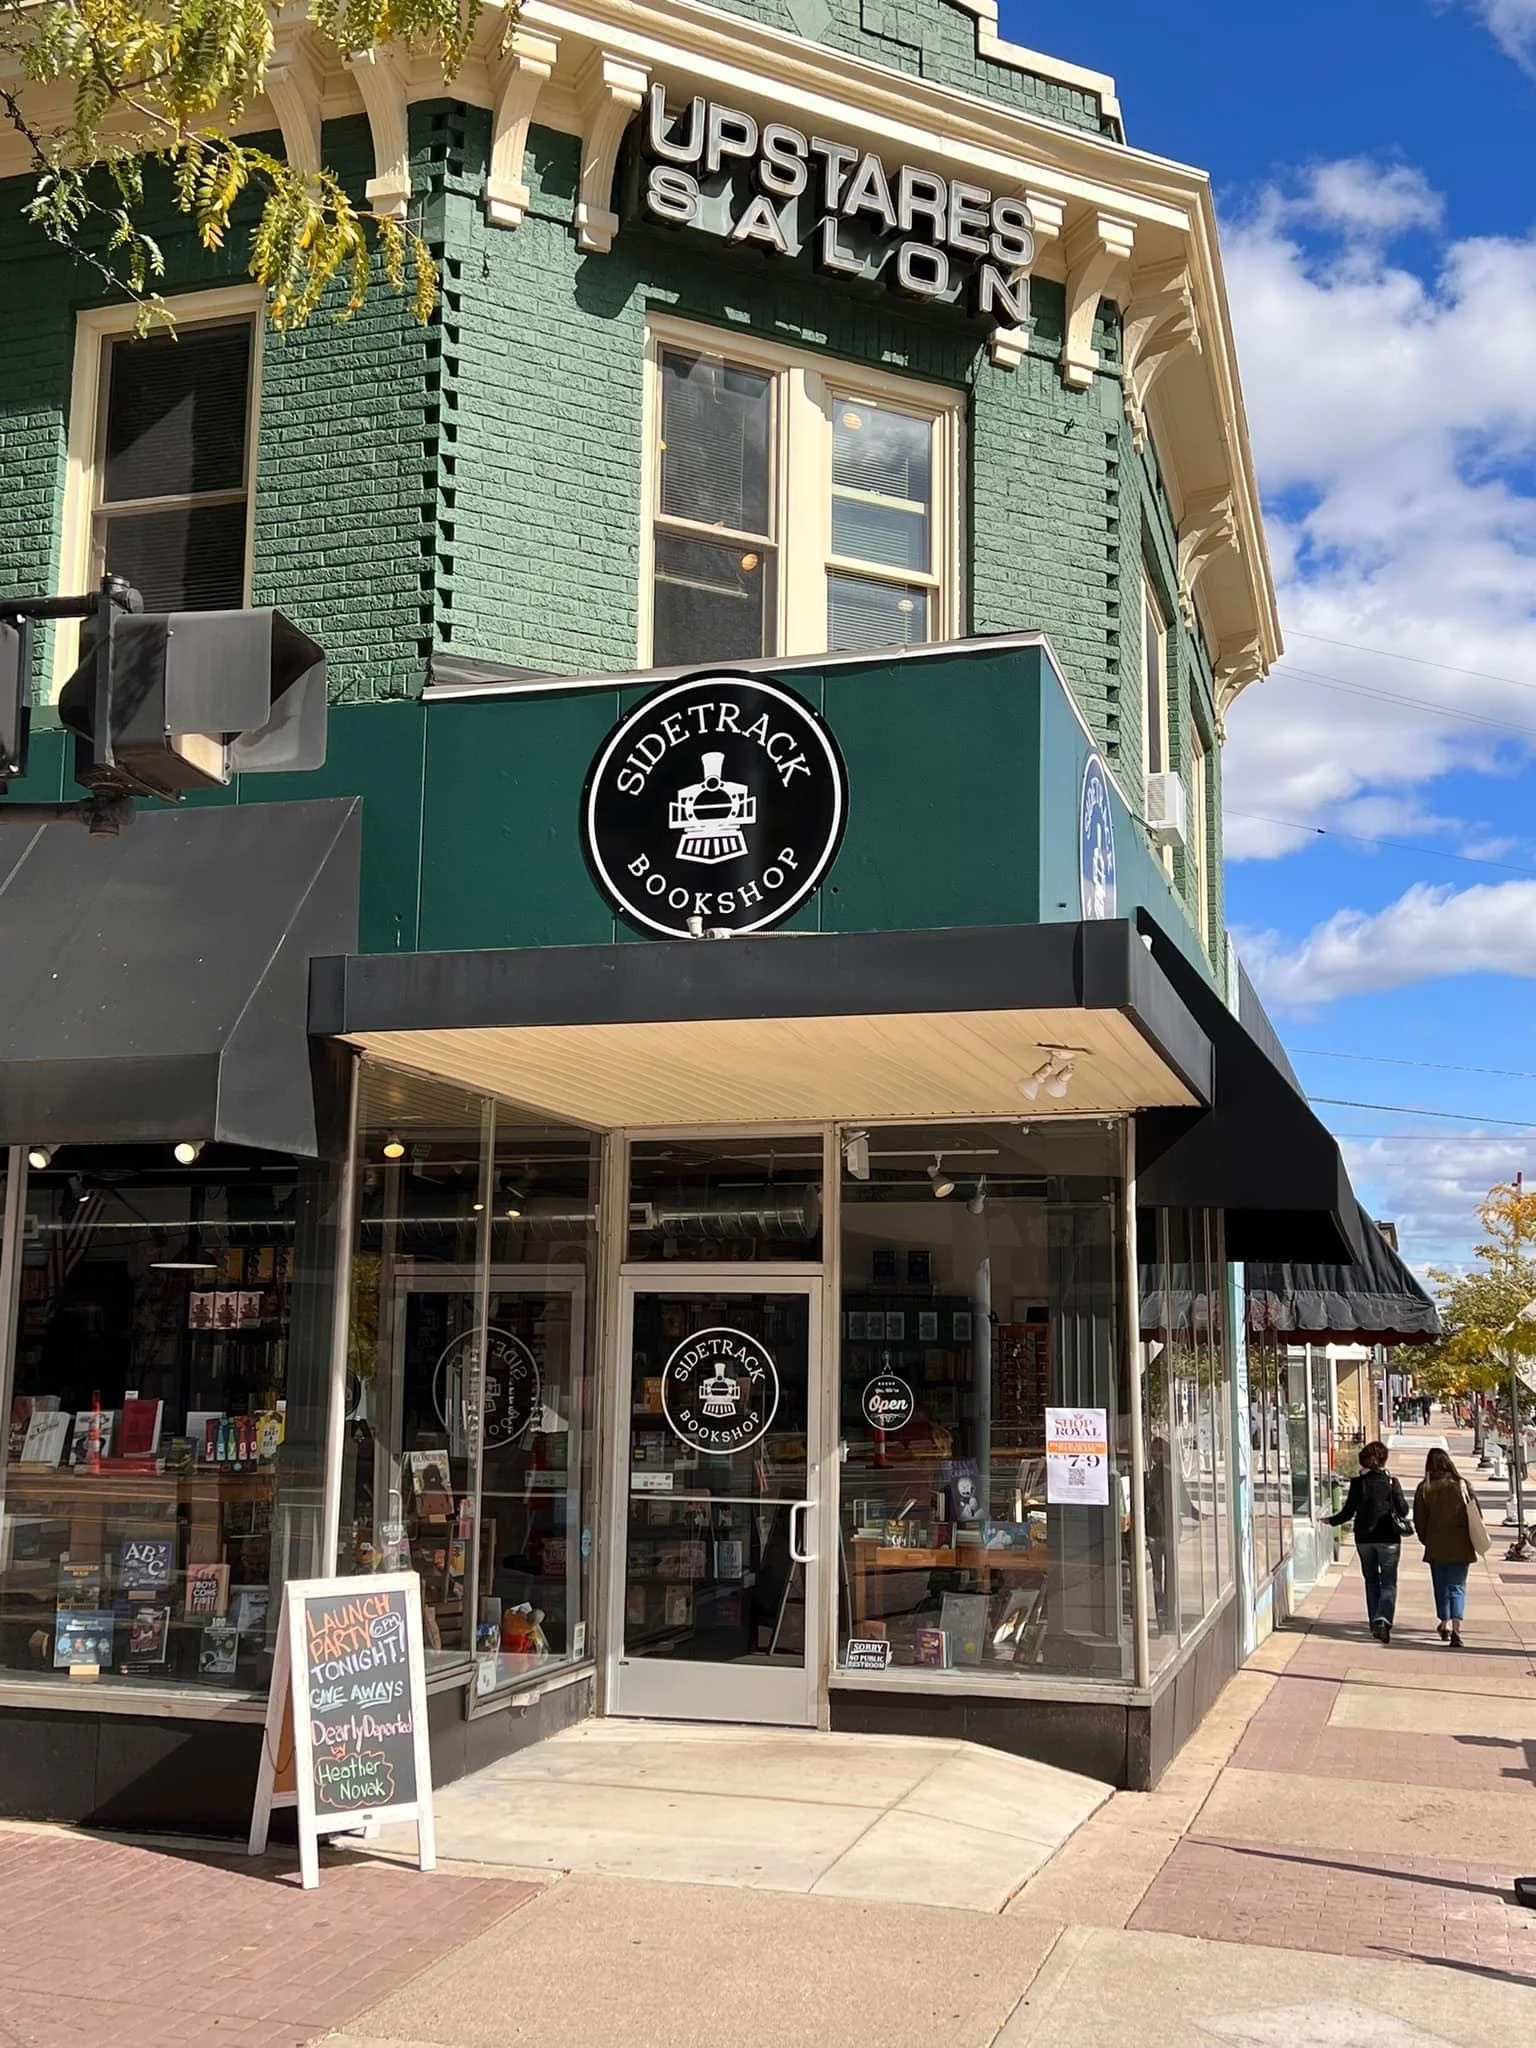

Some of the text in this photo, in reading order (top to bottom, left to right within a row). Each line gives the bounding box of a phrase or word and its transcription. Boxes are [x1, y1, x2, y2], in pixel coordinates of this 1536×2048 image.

[648, 82, 1036, 268] UPSTARES
[645, 164, 1032, 326] SALON
[616, 702, 812, 798] SIDETRACK
[627, 846, 801, 917] BOOKSHOP
[674, 1338, 766, 1384] SIDETRACK
[869, 1395, 909, 1413] Open
[679, 1409, 760, 1443] BOOKSHOP
[1055, 1420, 1093, 1429] SHOP
[1056, 1428, 1101, 1437] ROYAL
[1068, 1454, 1101, 1468] 7-9
[306, 1594, 390, 1638] LAUNCH
[310, 1615, 398, 1664] PARTY 6PM
[311, 1620, 405, 1684] TONIGHT!
[853, 1643, 884, 1653] SORRY
[860, 1655, 884, 1663] PUBLIC
[309, 1680, 404, 1709] GIVE AWAYS
[311, 1714, 363, 1753] Dearly
[319, 1757, 382, 1784] Heather
[339, 1778, 387, 1800] Novak
